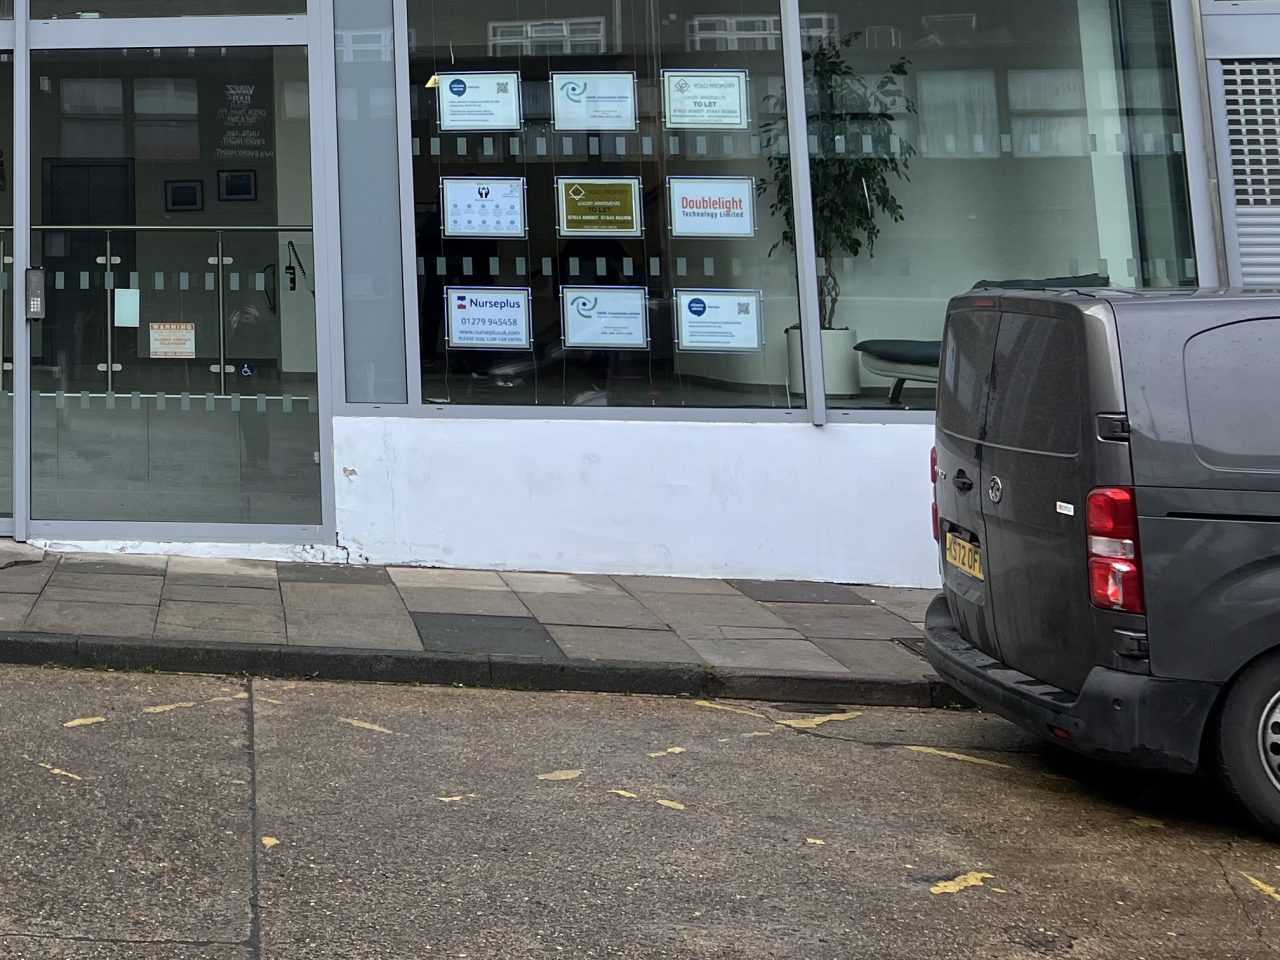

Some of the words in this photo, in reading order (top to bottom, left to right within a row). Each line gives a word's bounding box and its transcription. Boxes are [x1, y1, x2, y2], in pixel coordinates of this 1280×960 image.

[681, 196, 743, 213] Doublelight
[682, 210, 718, 219] Technology
[469, 298, 521, 311] Nurseplus
[461, 317, 486, 326] 01279
[488, 318, 518, 326] 945458
